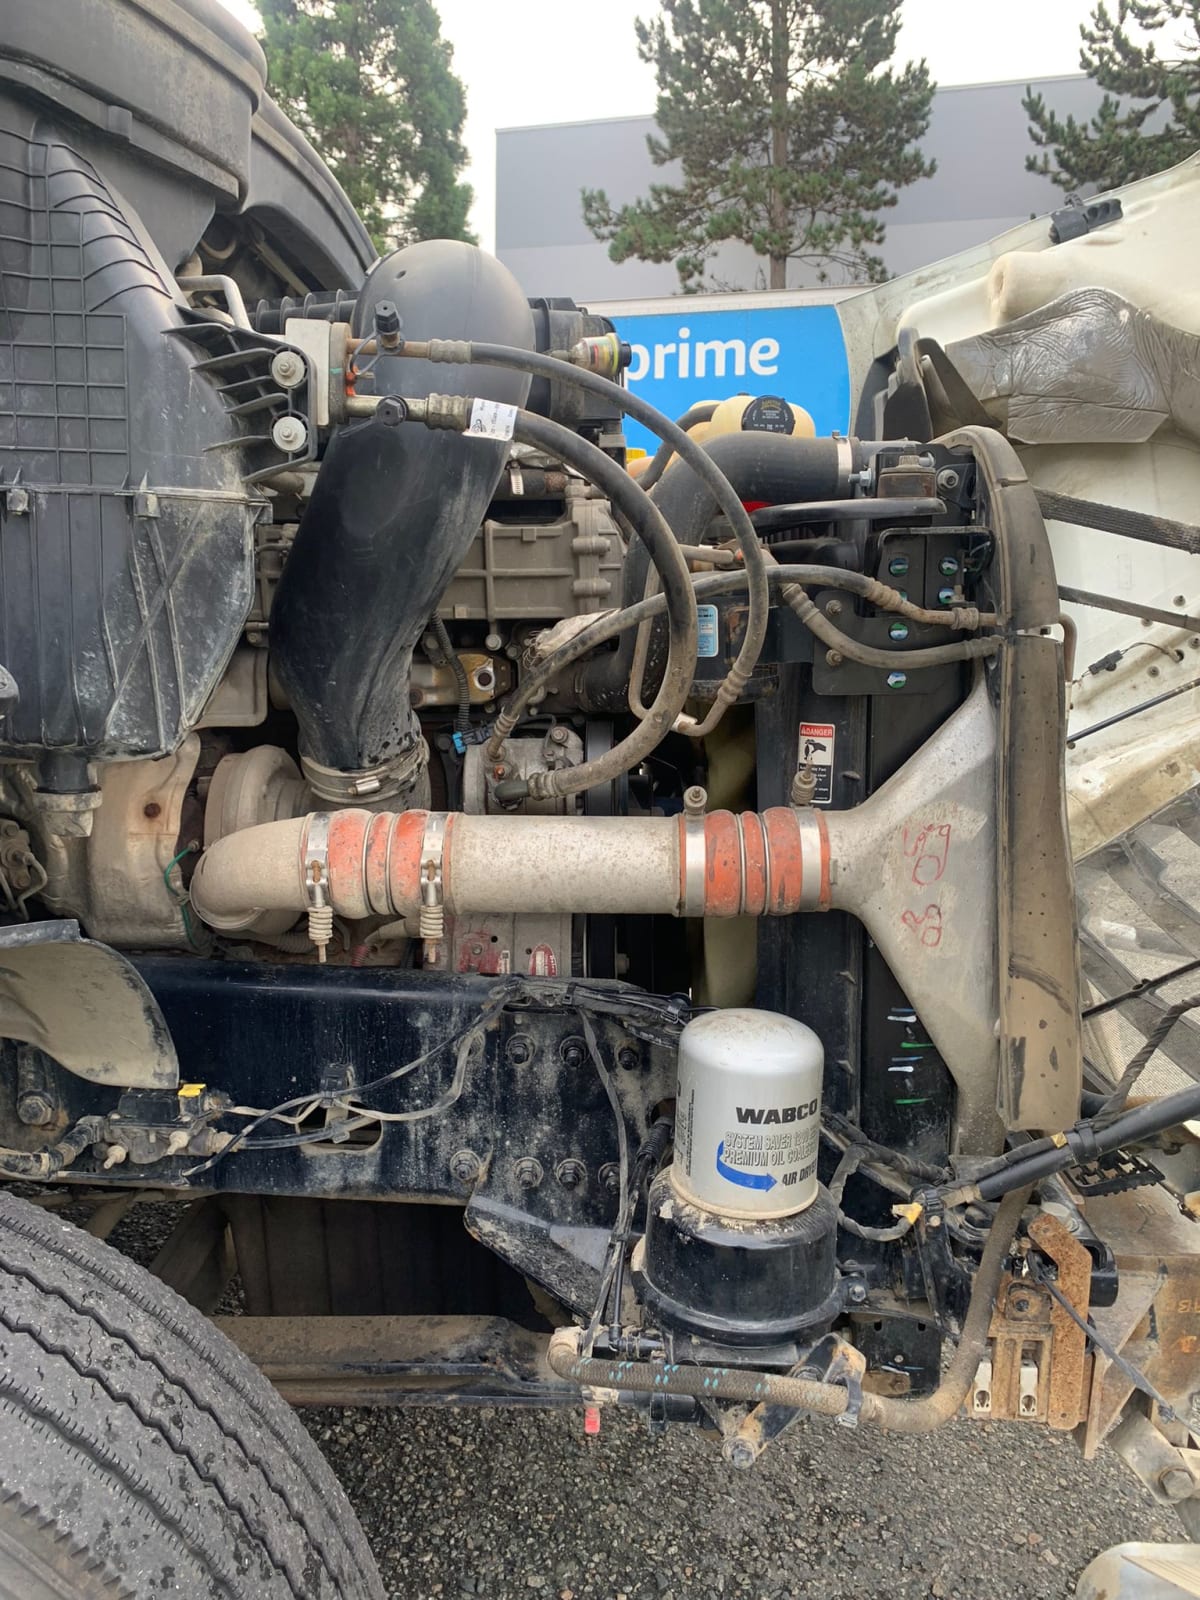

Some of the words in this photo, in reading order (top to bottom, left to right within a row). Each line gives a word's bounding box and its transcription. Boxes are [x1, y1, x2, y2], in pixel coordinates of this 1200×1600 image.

[624, 327, 780, 389] prime
[805, 728, 832, 737] DANGER
[736, 1098, 818, 1124] WABCO
[725, 1131, 763, 1150] SYSTEM
[765, 1133, 792, 1150] SAVER
[724, 1148, 769, 1166] PREMIUM
[771, 1150, 785, 1166] OIL
[782, 1170, 797, 1186] AIR
